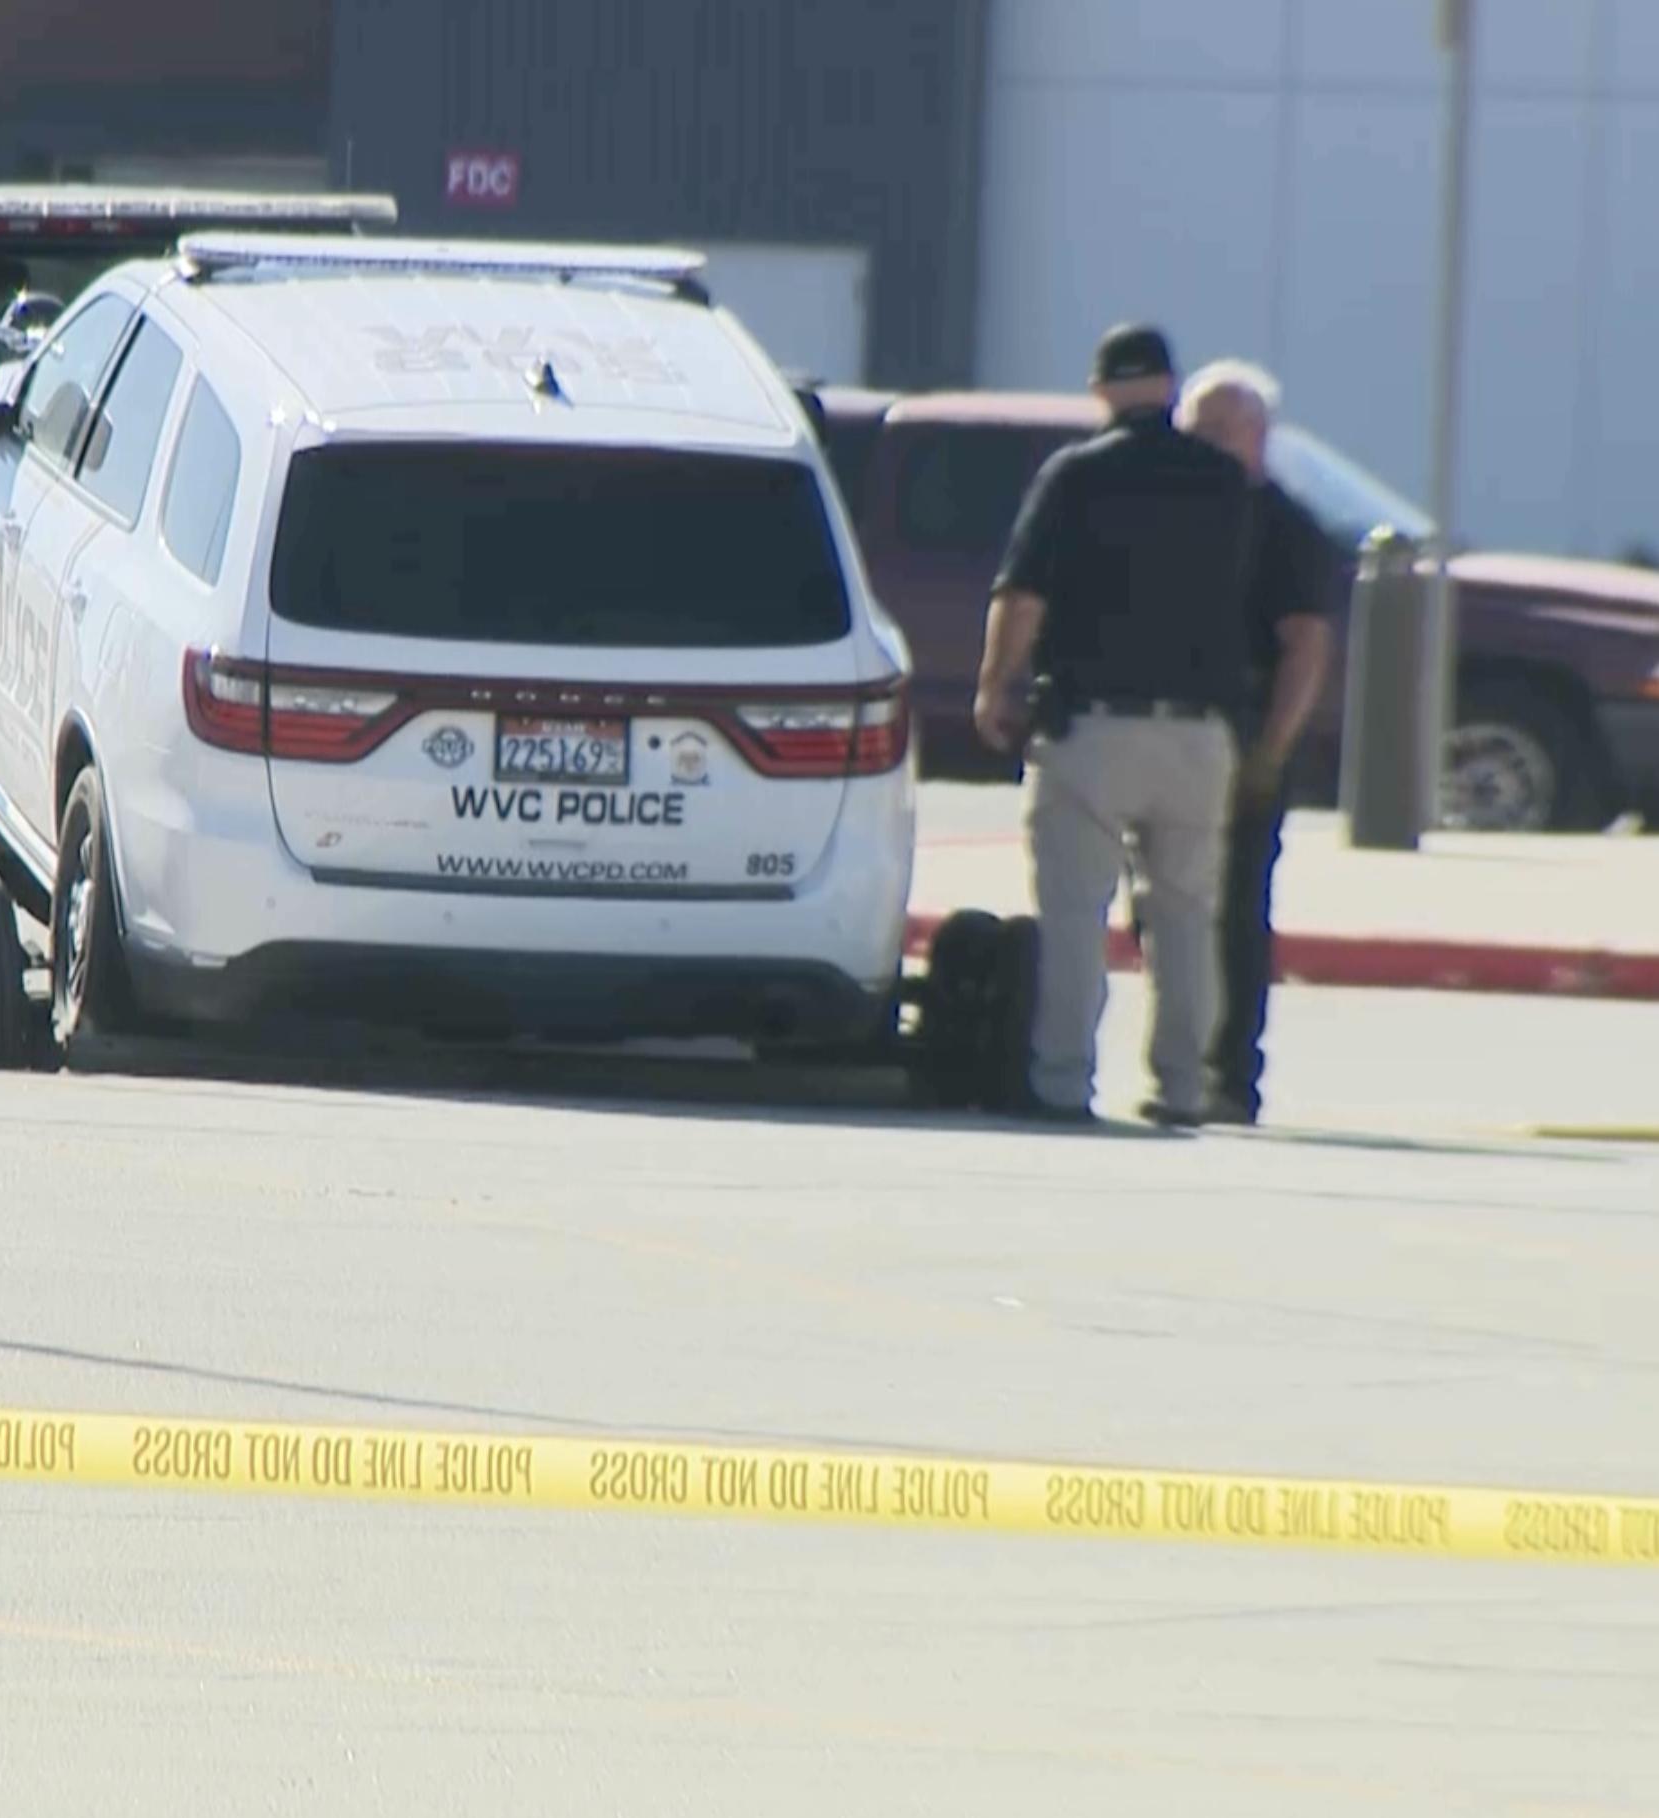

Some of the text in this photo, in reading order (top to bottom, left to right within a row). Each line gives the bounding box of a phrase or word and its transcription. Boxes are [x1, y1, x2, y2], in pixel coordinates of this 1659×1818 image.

[448, 157, 513, 197] FDC
[451, 785, 542, 822] WVC
[556, 792, 685, 826] POLICE
[436, 854, 688, 880] WWW.WVCPD.COM
[745, 853, 795, 877] 805
